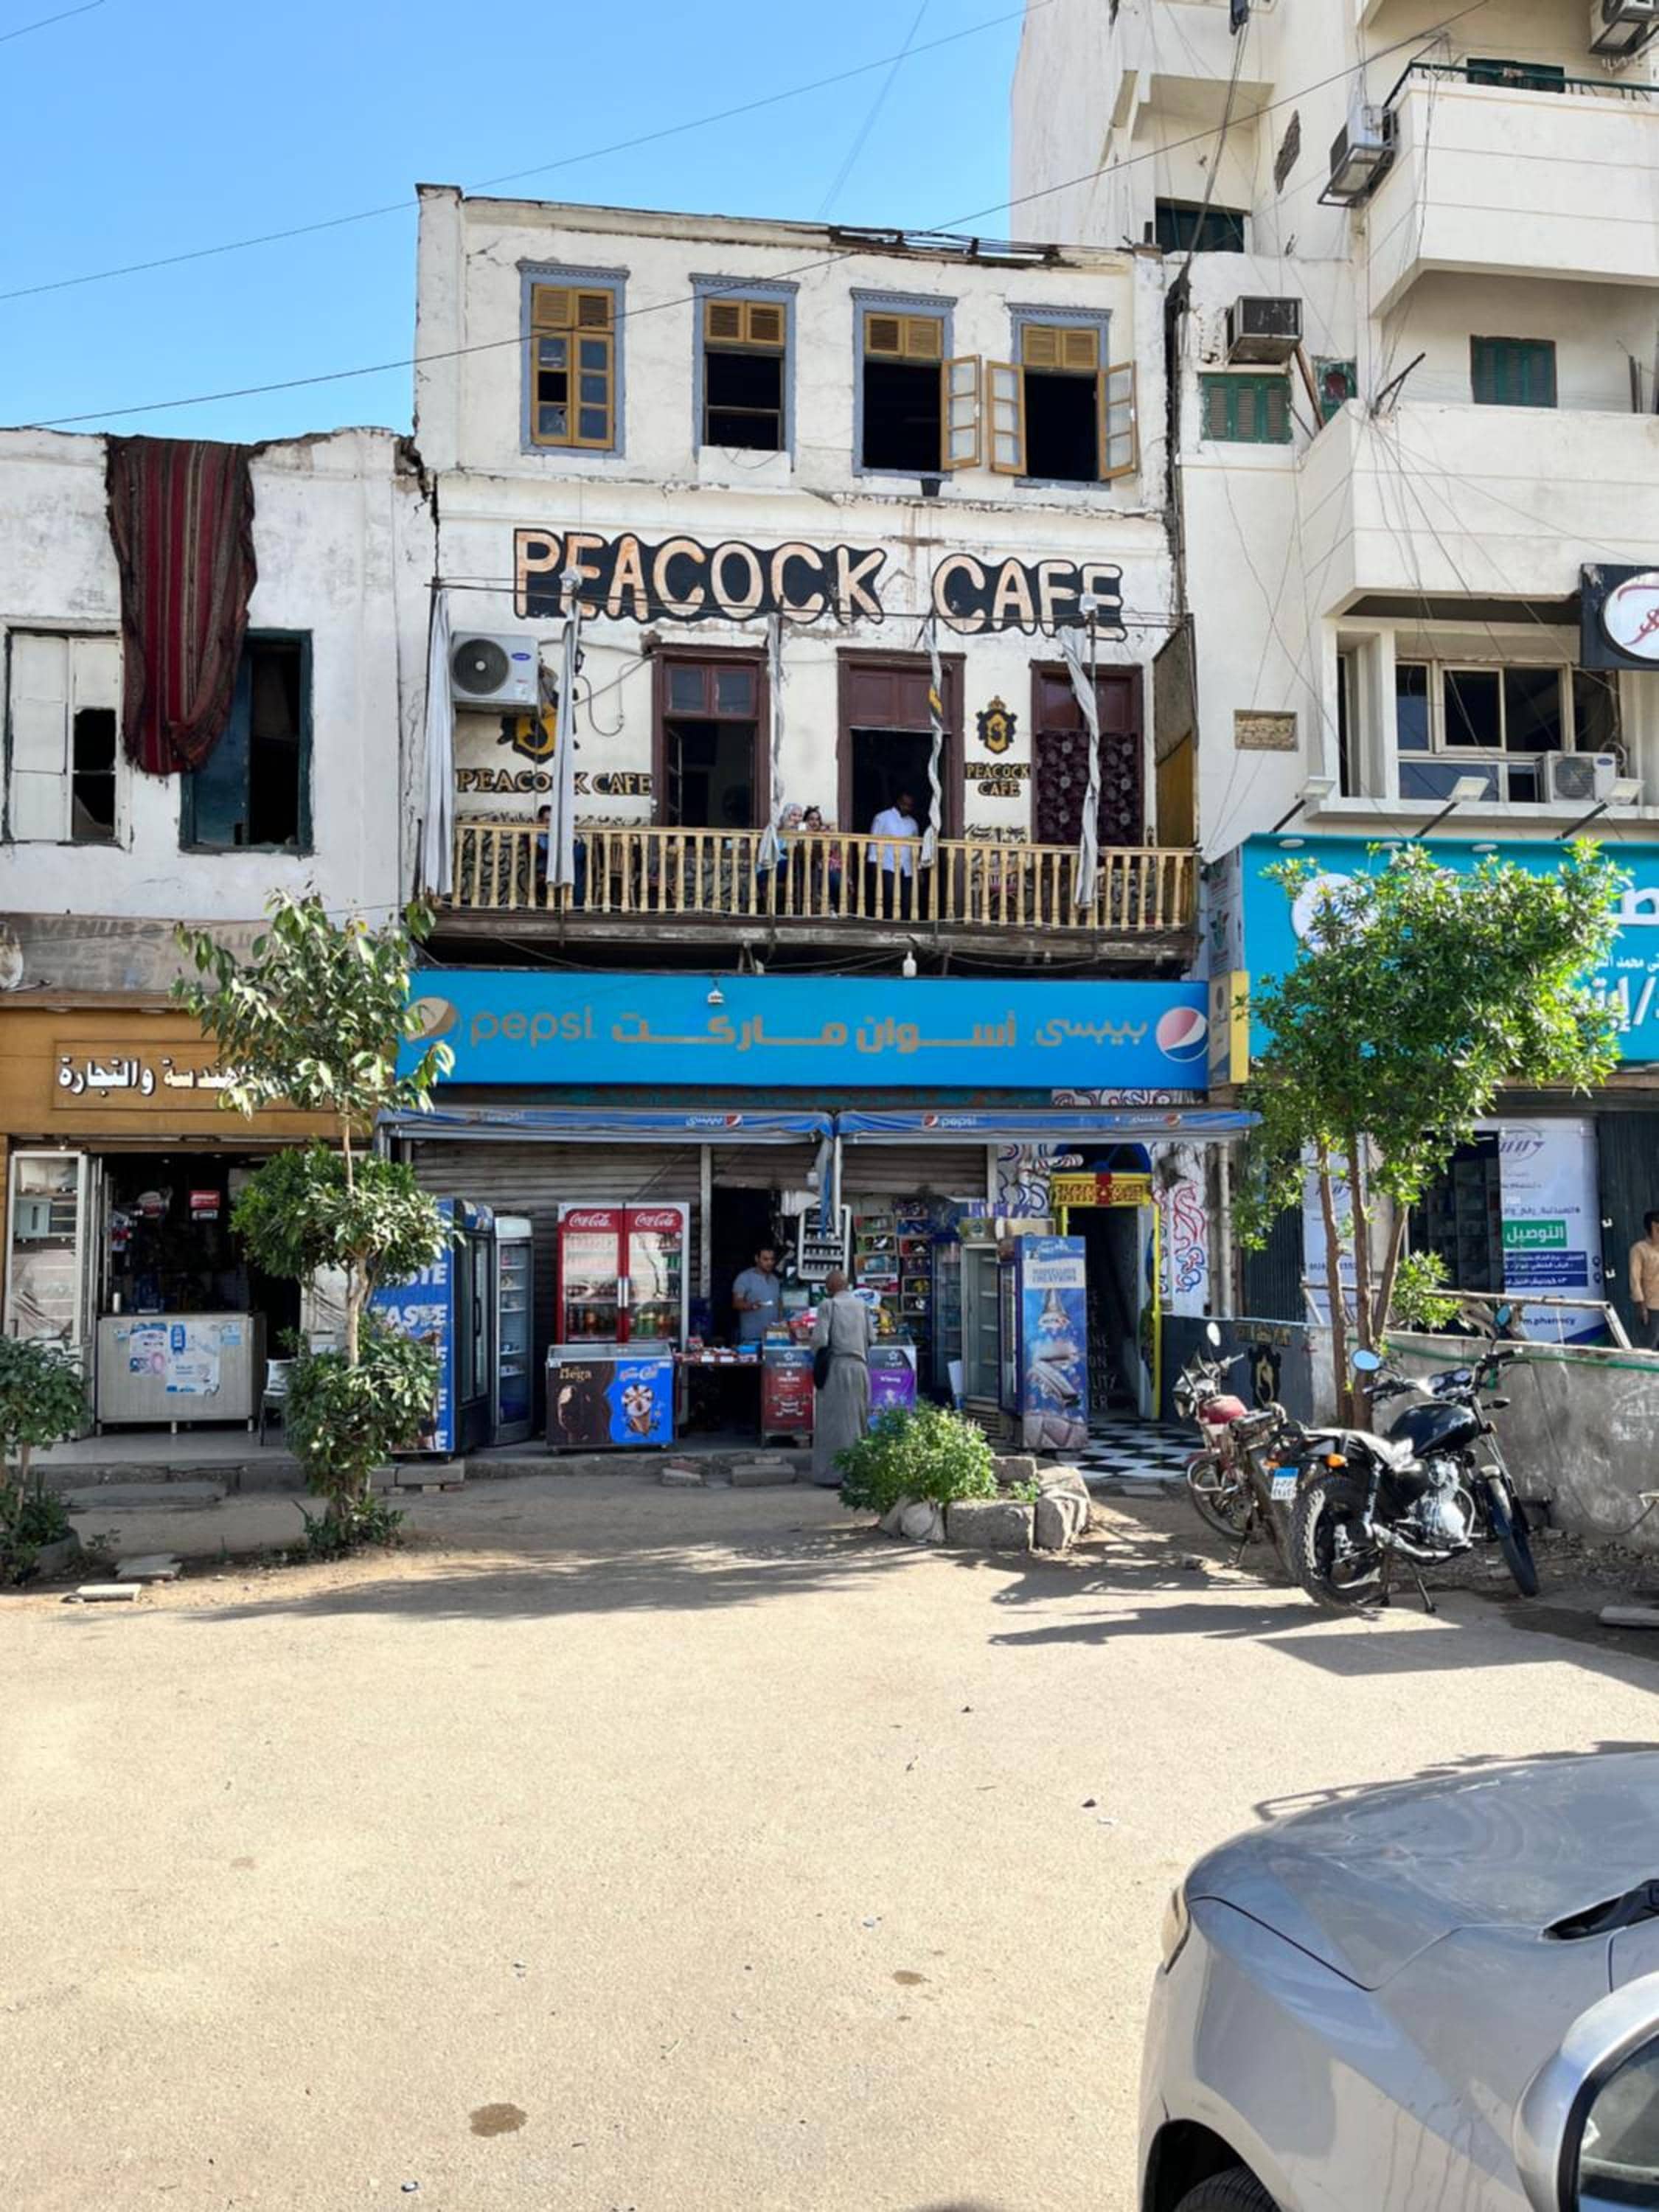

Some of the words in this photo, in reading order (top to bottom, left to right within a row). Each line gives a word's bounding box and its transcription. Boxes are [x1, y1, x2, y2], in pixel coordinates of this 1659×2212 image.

[514, 528, 887, 625] PEACOCK
[933, 554, 1127, 640] CAFE
[456, 769, 589, 794] PEACOK
[592, 772, 653, 796] CAFE
[964, 762, 1031, 779] PEACOCK
[978, 781, 1020, 796] CAFE
[470, 1006, 593, 1048] pepsi
[58, 1057, 153, 1097] والتجارة
[1506, 1225, 1564, 1243] التوصيل
